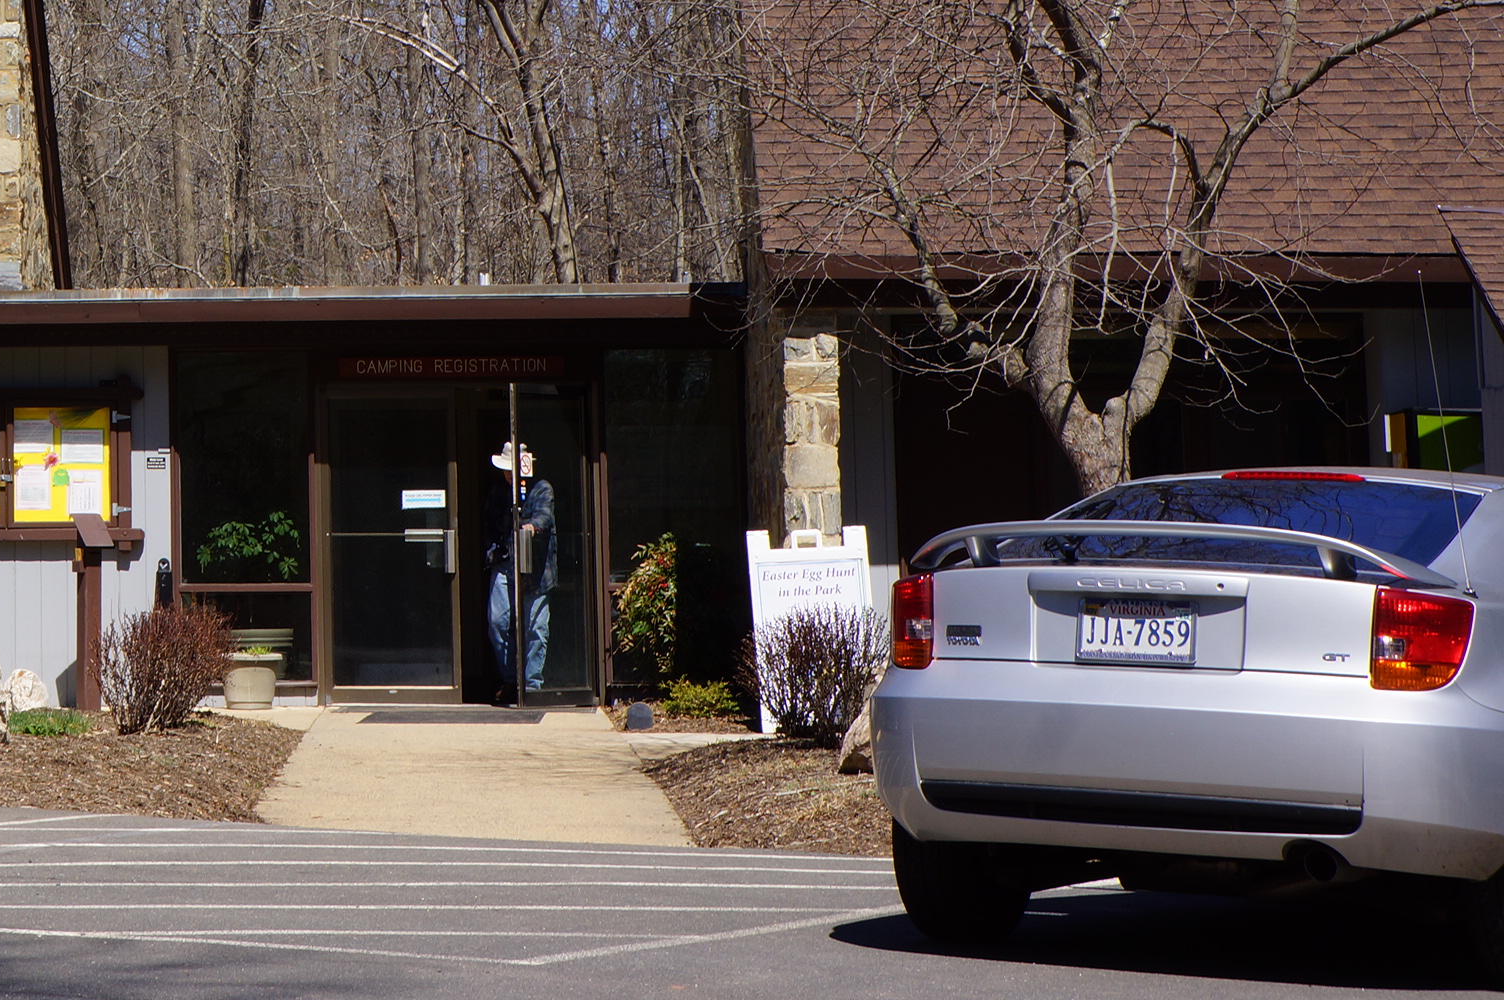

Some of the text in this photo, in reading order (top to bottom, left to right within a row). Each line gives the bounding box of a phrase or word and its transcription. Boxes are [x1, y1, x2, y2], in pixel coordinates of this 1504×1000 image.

[356, 358, 547, 374] CAMPING REGISTRATION
[762, 567, 856, 582] Easter Egg Hunt
[778, 583, 842, 598] in the Park
[1076, 577, 1187, 591] CELICA
[1109, 605, 1166, 616] VIRGINIA
[1086, 617, 1190, 648] JJA-7859
[946, 636, 980, 646] TOYOTA
[1322, 653, 1351, 662] GT
